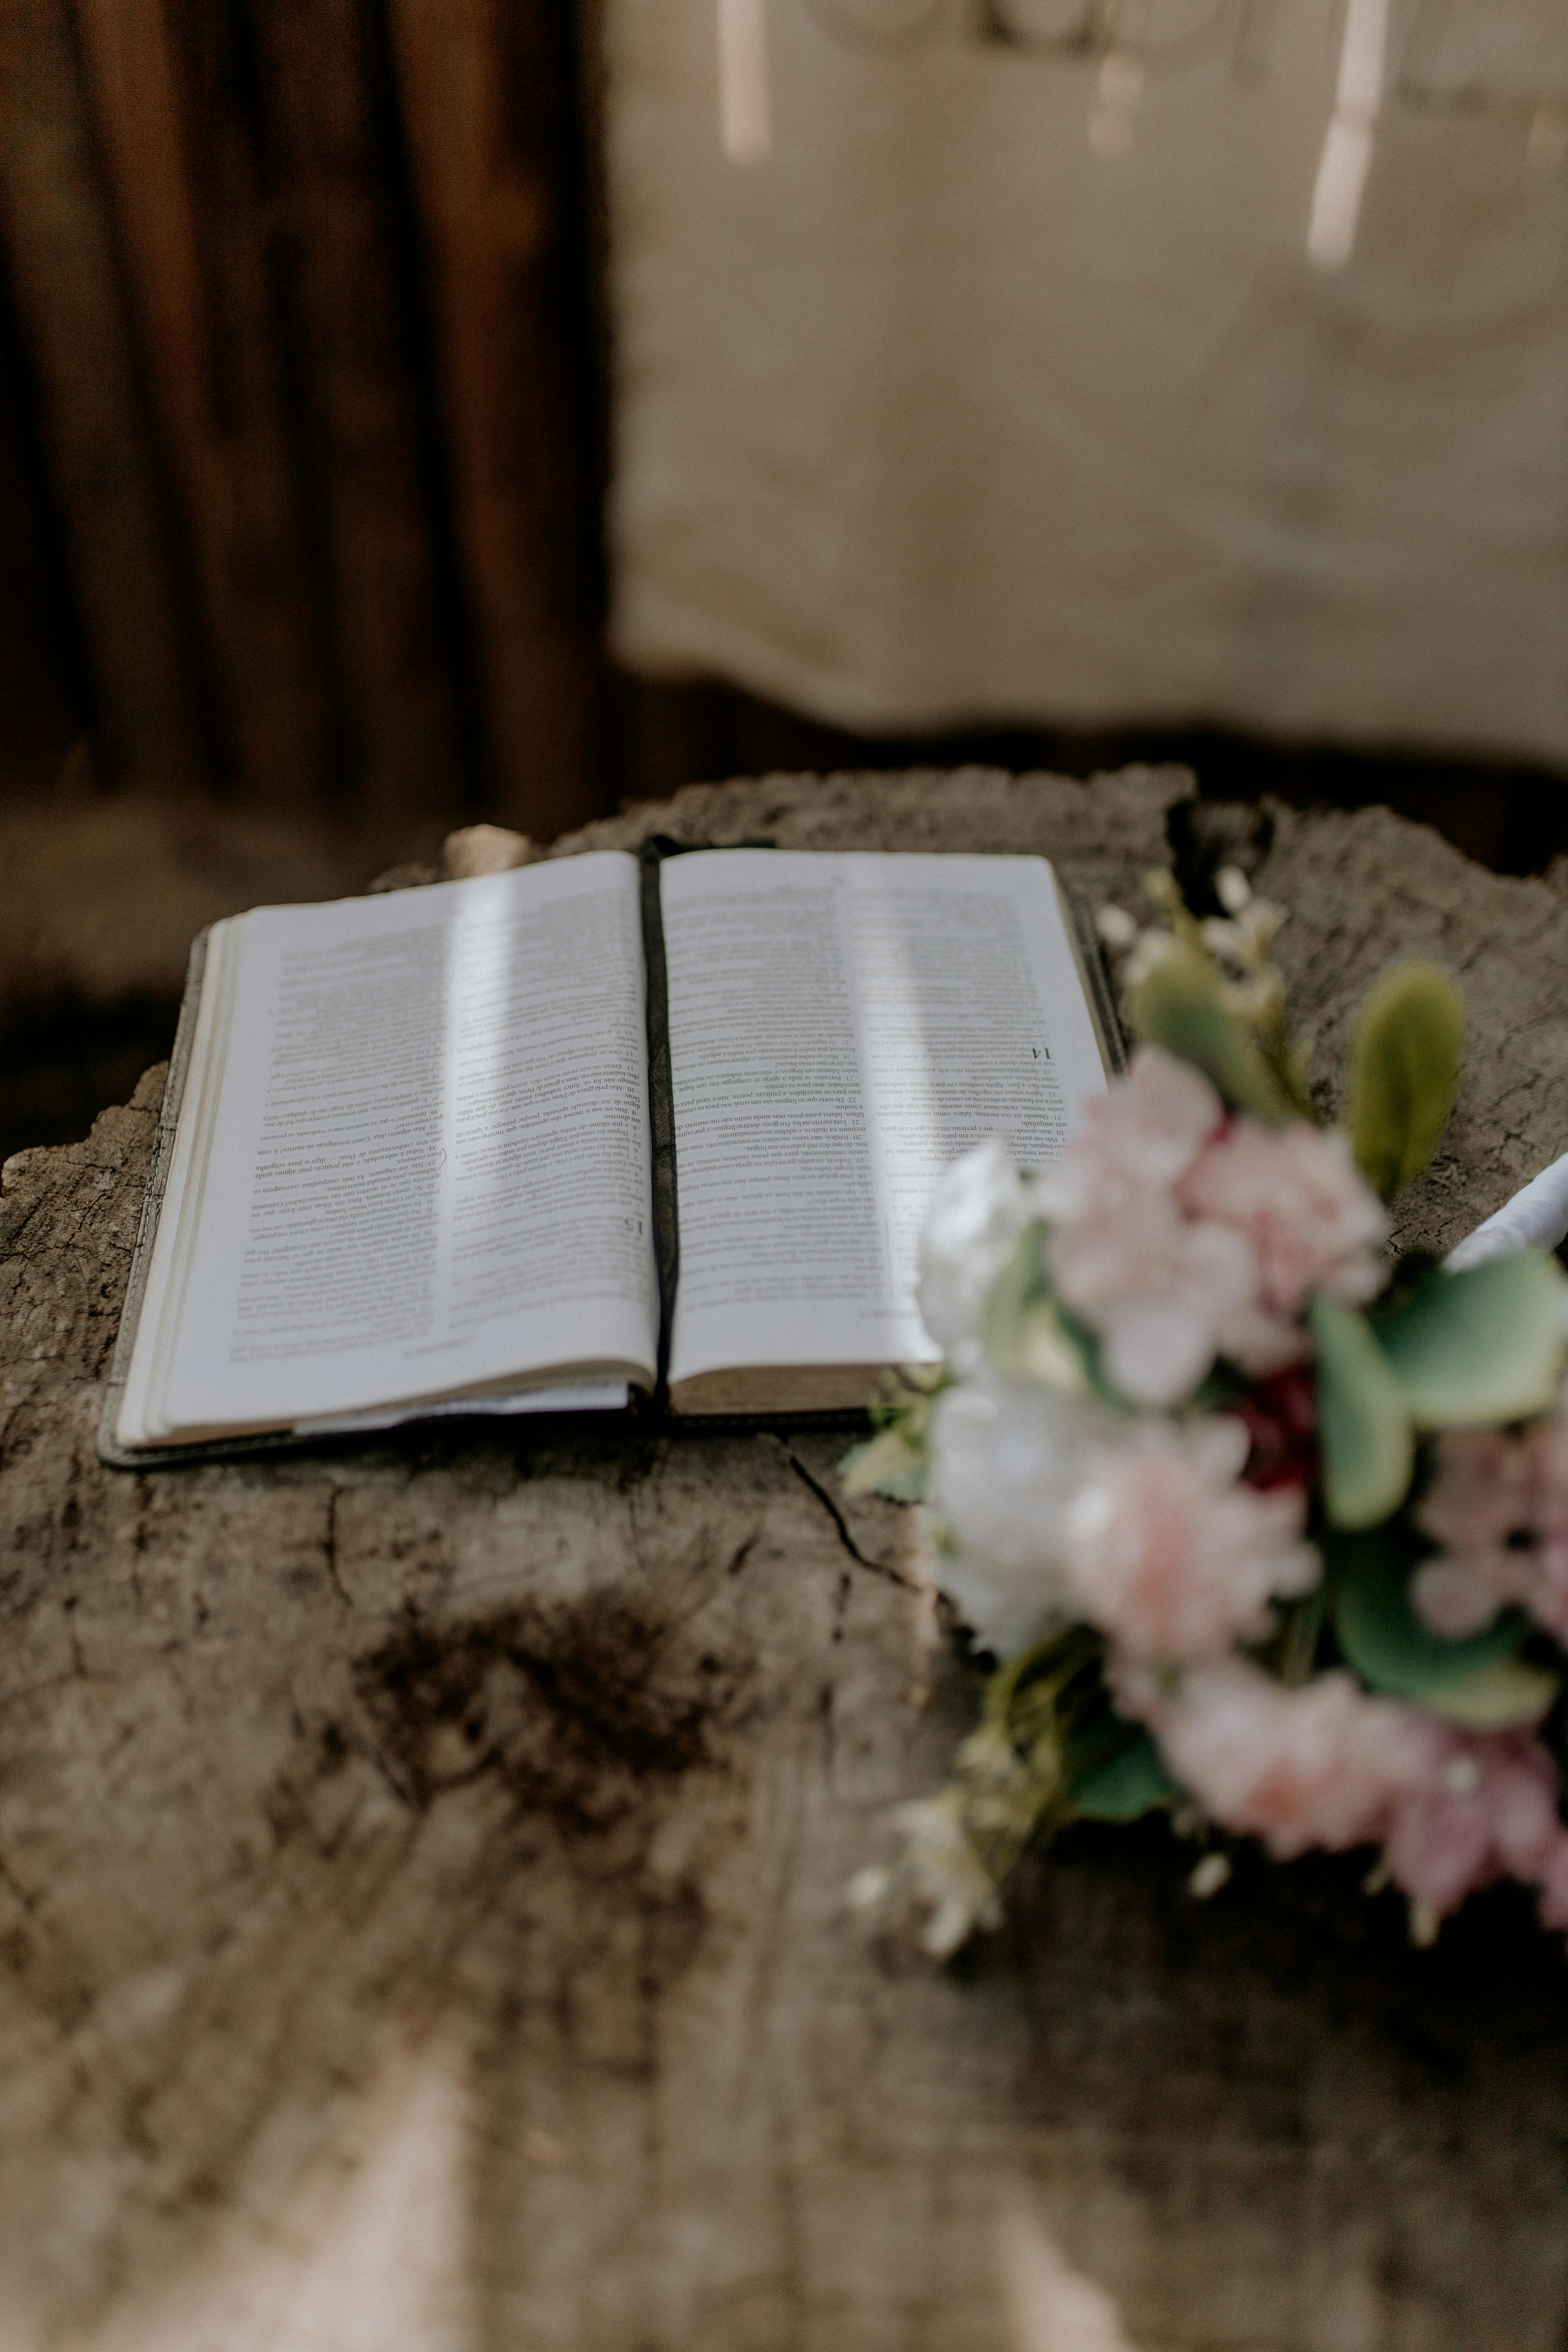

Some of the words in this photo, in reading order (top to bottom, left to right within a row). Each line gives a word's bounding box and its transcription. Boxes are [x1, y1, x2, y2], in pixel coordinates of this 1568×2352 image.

[1032, 1047, 1051, 1059] 14
[577, 1085, 593, 1093] graça
[571, 1100, 599, 1110] chamado
[623, 1100, 640, 1110] digno
[471, 1111, 487, 1119] graça
[518, 1112, 539, 1122] porque
[564, 1110, 583, 1118] menor
[395, 1122, 413, 1131] virão?
[491, 1118, 516, 1129] persegui
[389, 1128, 411, 1136] alguém
[466, 1127, 482, 1135] igreja
[481, 1130, 504, 1138] mesmo
[280, 1145, 304, 1153] mortos?
[298, 1165, 311, 1174] pois
[302, 1178, 339, 1188] companhias
[263, 1184, 299, 1193] corrompem
